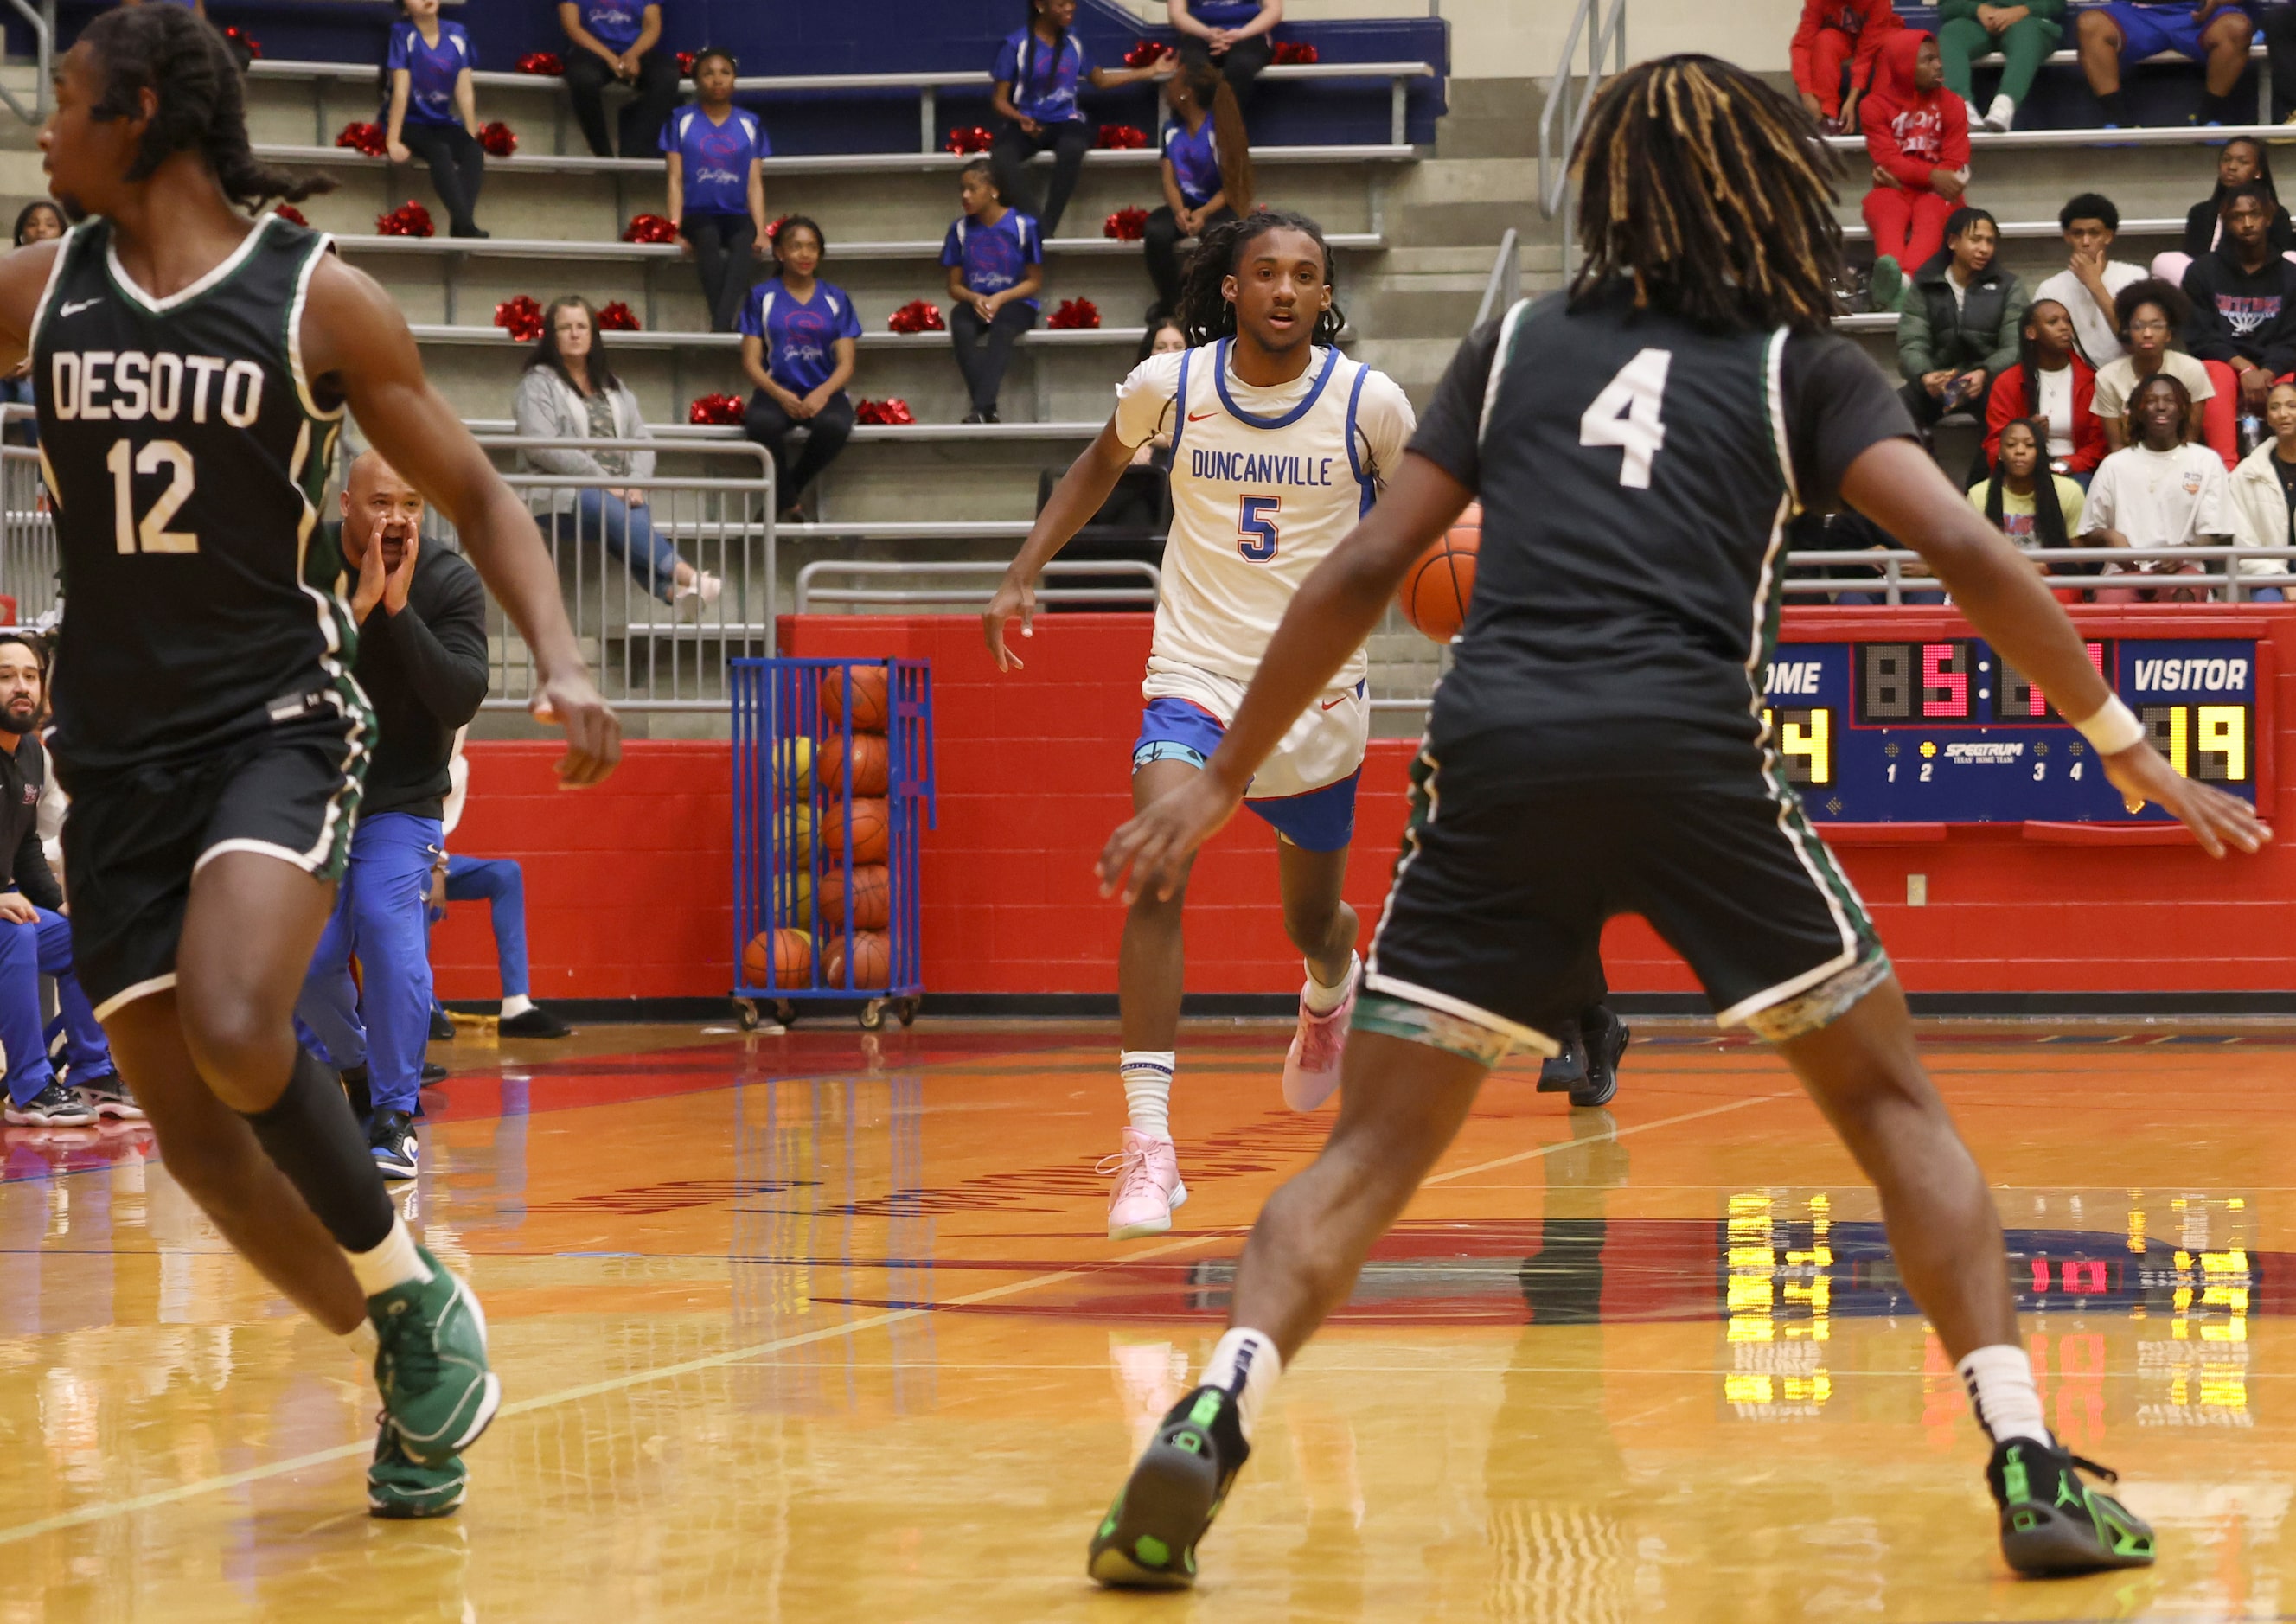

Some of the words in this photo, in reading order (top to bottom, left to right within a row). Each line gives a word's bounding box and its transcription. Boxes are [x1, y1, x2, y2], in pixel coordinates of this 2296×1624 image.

[52, 350, 265, 429] DESOTO
[1579, 348, 1672, 489] 4
[1192, 449, 1333, 486] DUNCANVILLE
[106, 438, 199, 555] 12
[1237, 494, 1281, 563] 5
[1763, 662, 1822, 694] OME
[2134, 658, 2248, 691] VISITOR
[1943, 743, 2024, 758] SPECTRUM
[2169, 705, 2246, 781] 19
[1887, 763, 1898, 783] 1
[1919, 762, 1934, 783] 2
[2032, 761, 2046, 782] 3
[2069, 761, 2083, 782] 4
